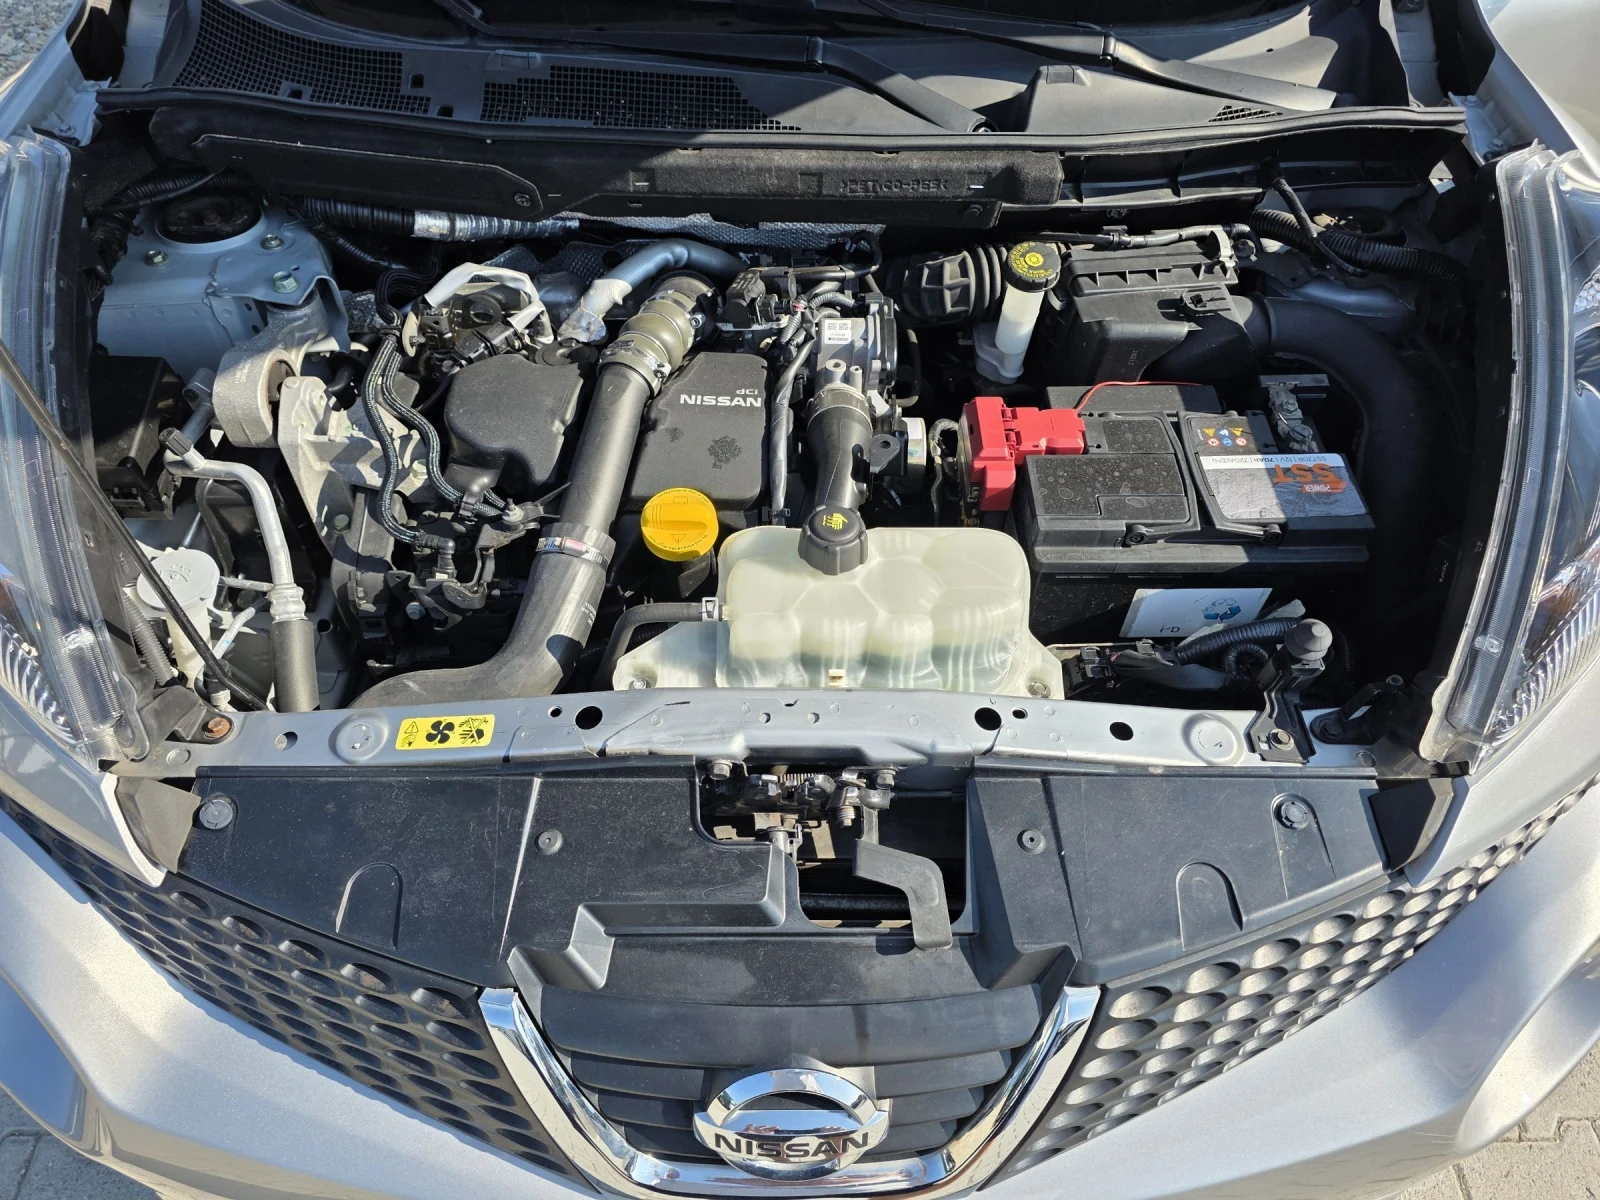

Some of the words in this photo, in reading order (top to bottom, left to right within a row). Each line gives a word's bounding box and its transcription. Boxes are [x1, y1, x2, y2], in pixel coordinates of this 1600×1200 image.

[680, 394, 762, 407] NISSAN
[1273, 463, 1333, 483] SST
[1304, 484, 1331, 492] POWER
[715, 1132, 869, 1158] NISSAN
